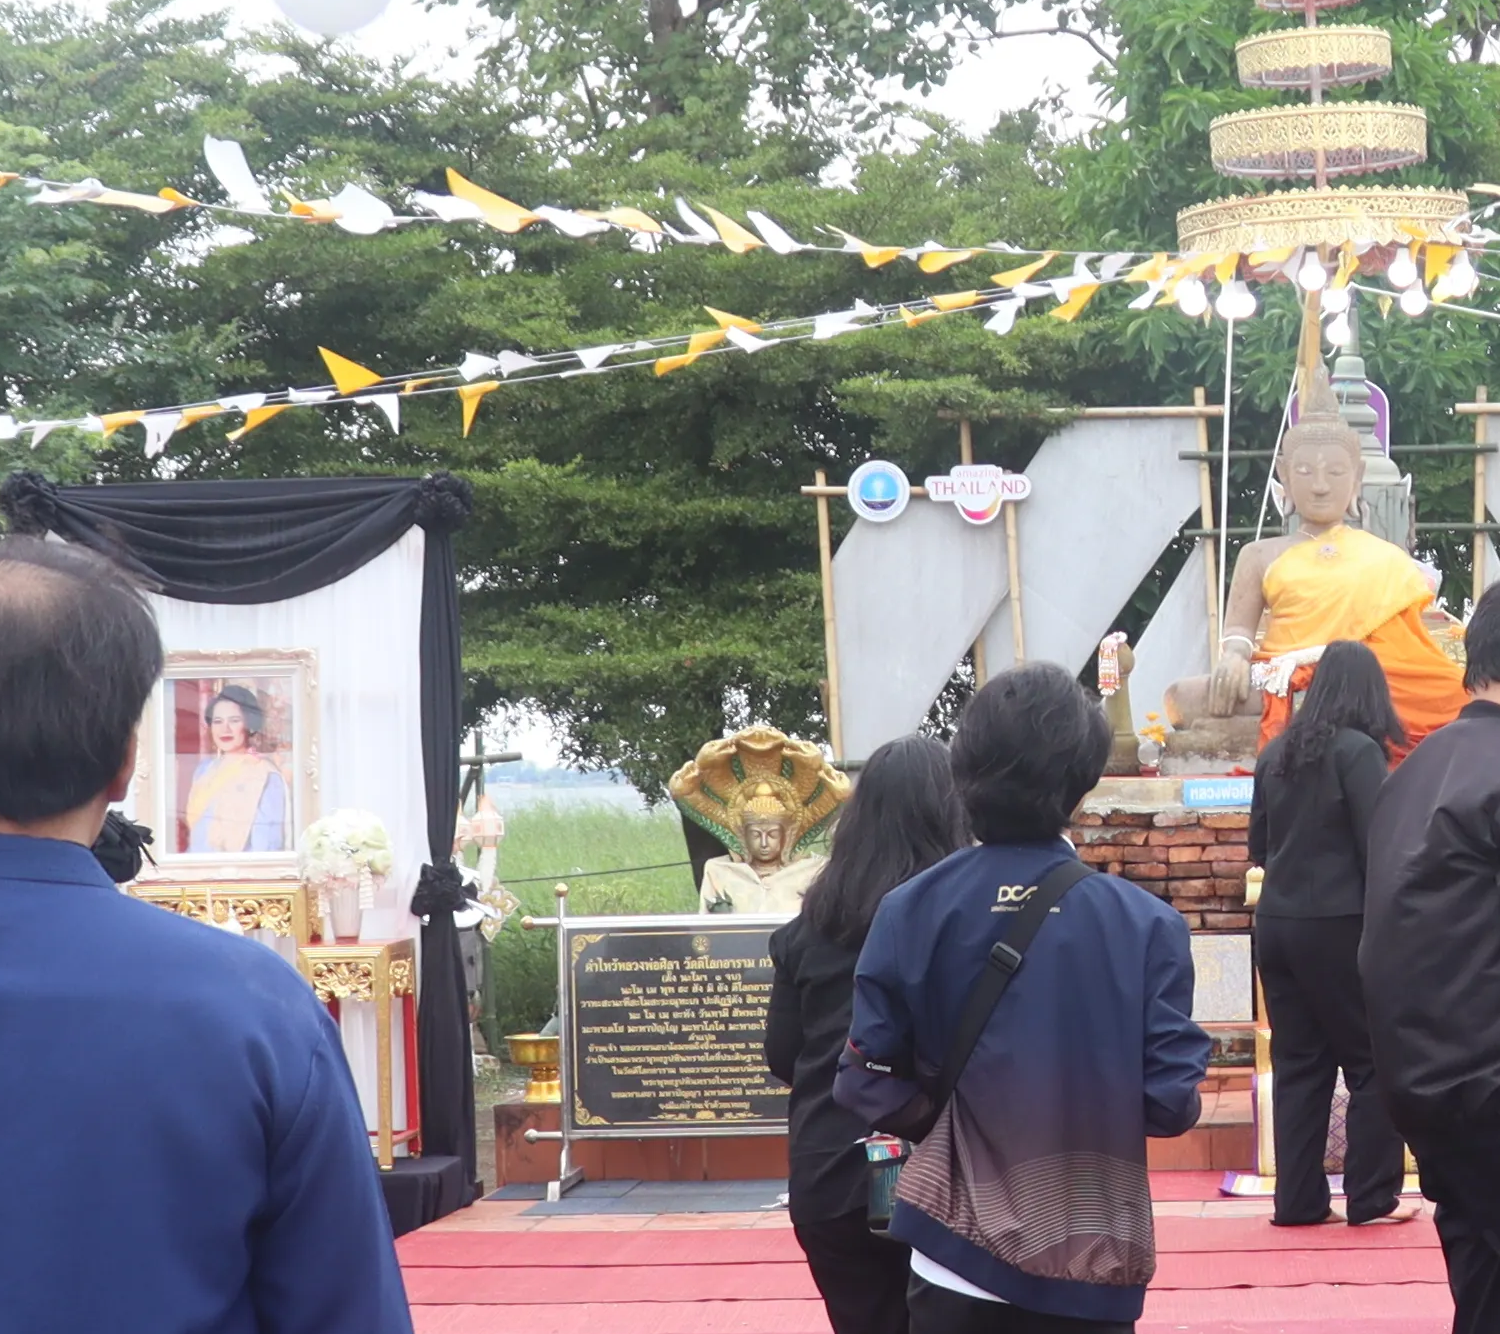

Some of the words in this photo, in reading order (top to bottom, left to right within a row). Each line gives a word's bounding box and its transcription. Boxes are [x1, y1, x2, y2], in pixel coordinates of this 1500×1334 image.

[956, 468, 1000, 479] amazing
[931, 479, 1026, 496] THAILAND
[684, 954, 755, 970] วัดติโลกอาราม
